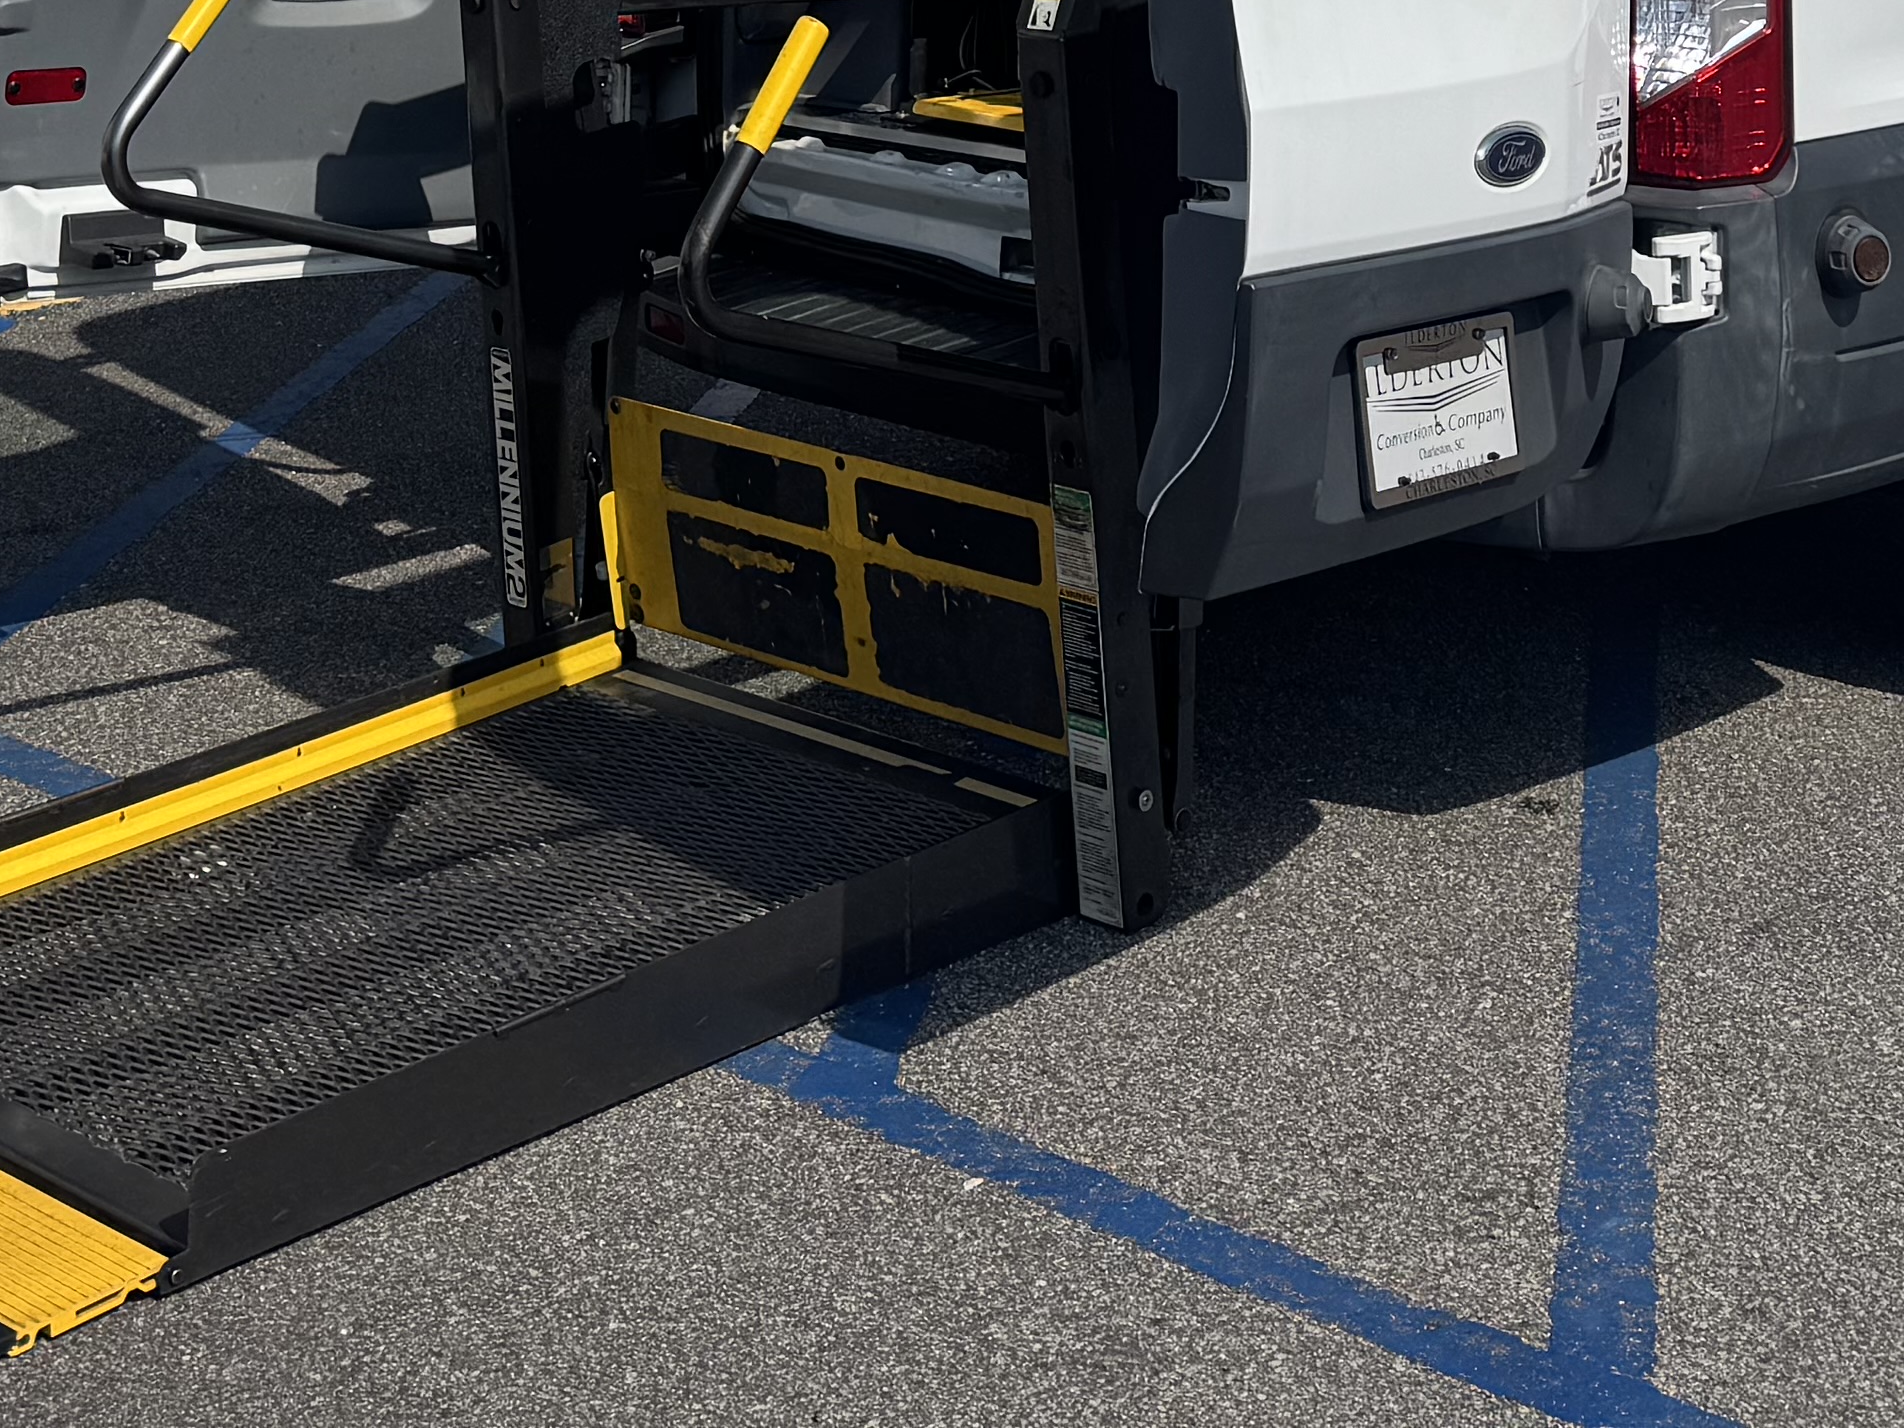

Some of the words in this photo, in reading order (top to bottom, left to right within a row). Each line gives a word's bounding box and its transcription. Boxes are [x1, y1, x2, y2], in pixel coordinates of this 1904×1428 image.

[1498, 139, 1536, 173] Ford
[1404, 321, 1467, 345] ILDERTON
[1377, 423, 1433, 450] Conversion
[1448, 406, 1506, 431] Company
